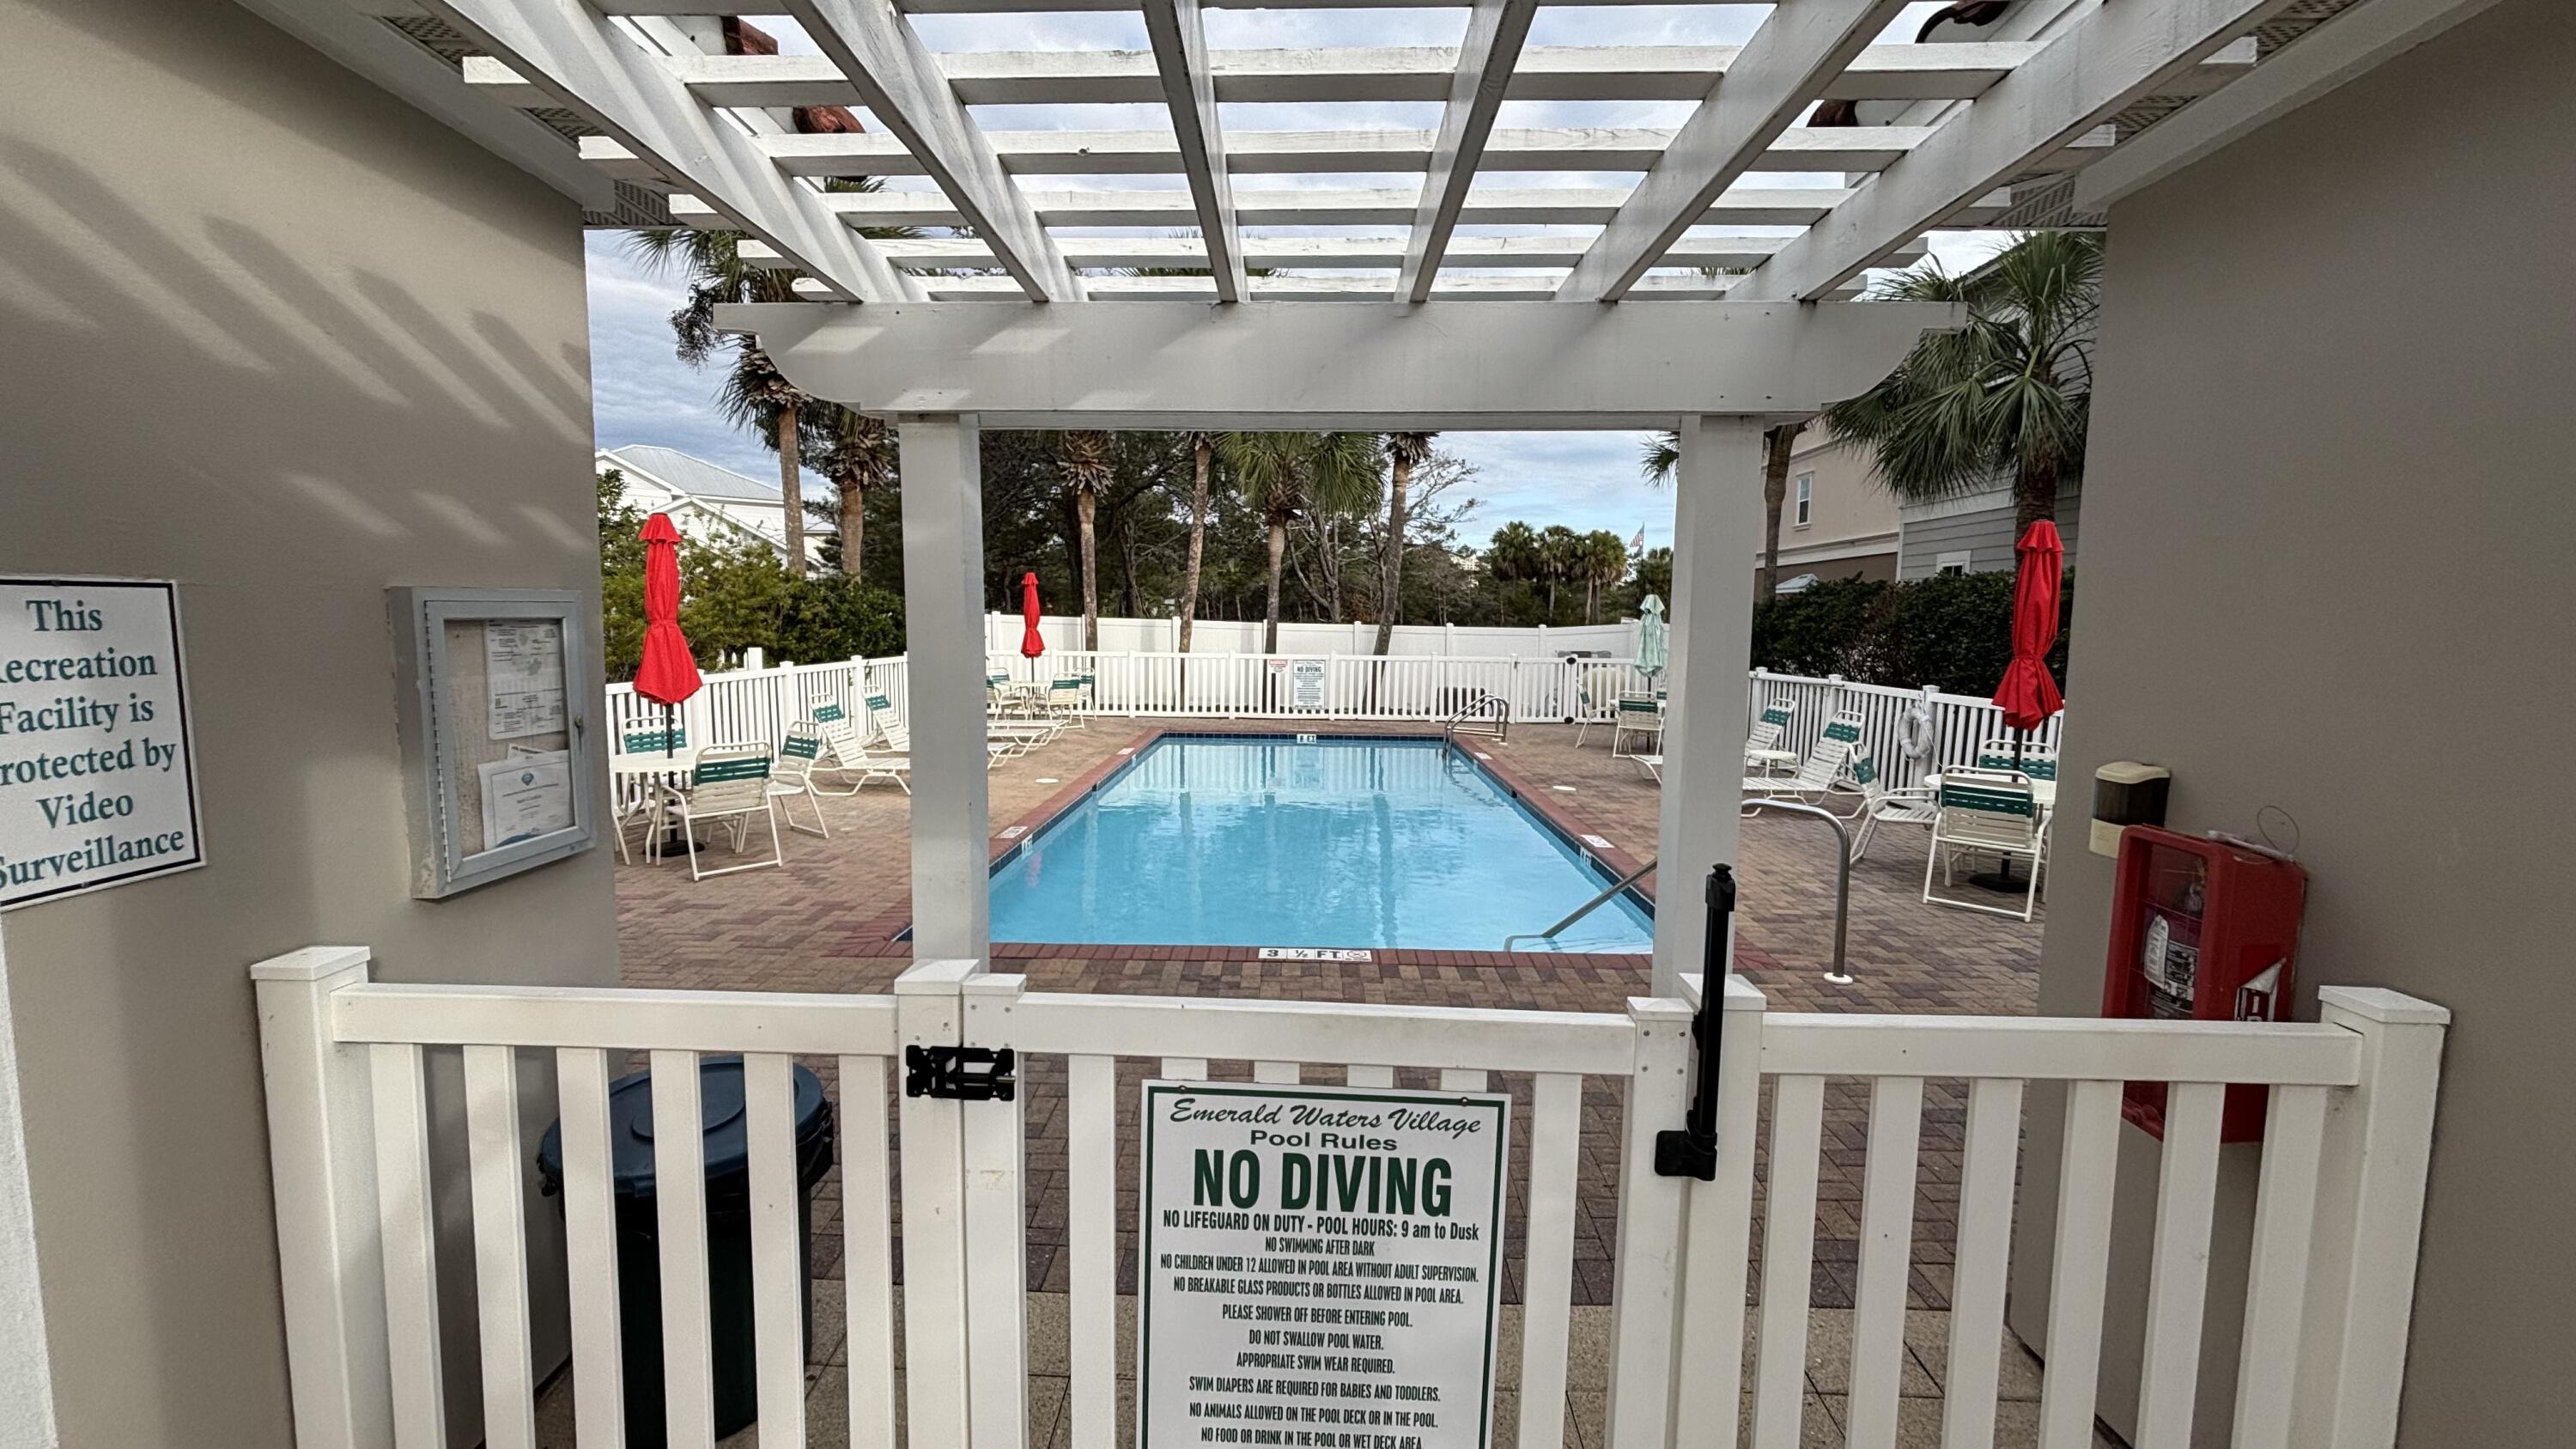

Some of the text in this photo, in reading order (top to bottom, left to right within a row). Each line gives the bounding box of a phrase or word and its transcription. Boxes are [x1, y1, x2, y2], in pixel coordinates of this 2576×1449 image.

[26, 600, 103, 631] This
[0, 647, 158, 684] ecreation
[0, 692, 154, 735] Facility is
[0, 737, 177, 786] rotected by
[35, 790, 134, 829] Video
[1170, 1098, 1480, 1140] Emerald Waters Village
[1250, 1129, 1397, 1151] Pool Rules
[1194, 1148, 1452, 1217] NO DIVING
[1163, 1209, 1180, 1227] NO
[1183, 1210, 1249, 1230] LIFEGUARD
[1253, 1213, 1270, 1231] ON
[1273, 1214, 1305, 1233] DUTY
[1316, 1215, 1348, 1234] POOL
[1352, 1217, 1397, 1237] HOURS:
[1401, 1220, 1409, 1238] 9
[1413, 1224, 1431, 1239] am
[1434, 1221, 1446, 1239] to
[1449, 1221, 1479, 1240] Dusk
[1265, 1236, 1376, 1257] NO SWIMMING AFTER DARK
[1160, 1253, 1479, 1282] NO CHILDREN UNDER 12 ALLOWED IN POOL AREA WITHOUT ADULT SUPERVISION.
[1173, 1275, 1464, 1304] NO BREAKABLE GLASS PRODUCTS OR BOTTLES ALLOWED IN POOL AREA.
[1222, 1304, 1413, 1327] PLEASE SHOWER OFF BEFORE ENTERING POOL.
[1249, 1329, 1384, 1349] DO NOT SWALLOW POOL WATER.
[1236, 1351, 1394, 1374] APPROPRIATE SWIM WEAR REQUIRED.
[1189, 1375, 1441, 1401] SWIM DIAPERS ARE REQUIRED FOR BABIES AND TODDLERS.
[1189, 1402, 1438, 1428] NO ANIMALS ALLOWED ON THE POOL DECK OR IN THE POOL.
[1200, 1427, 1213, 1441] NO
[1215, 1428, 1238, 1443] FOOD
[1240, 1428, 1252, 1443] OR
[1255, 1429, 1282, 1445] DRINK
[1285, 1430, 1294, 1446] IN
[1297, 1431, 1312, 1446] THE
[1314, 1432, 1336, 1447] POOL
[1338, 1433, 1351, 1448] OR
[1353, 1434, 1371, 1449] WET
[1373, 1434, 1396, 1449] DECK
